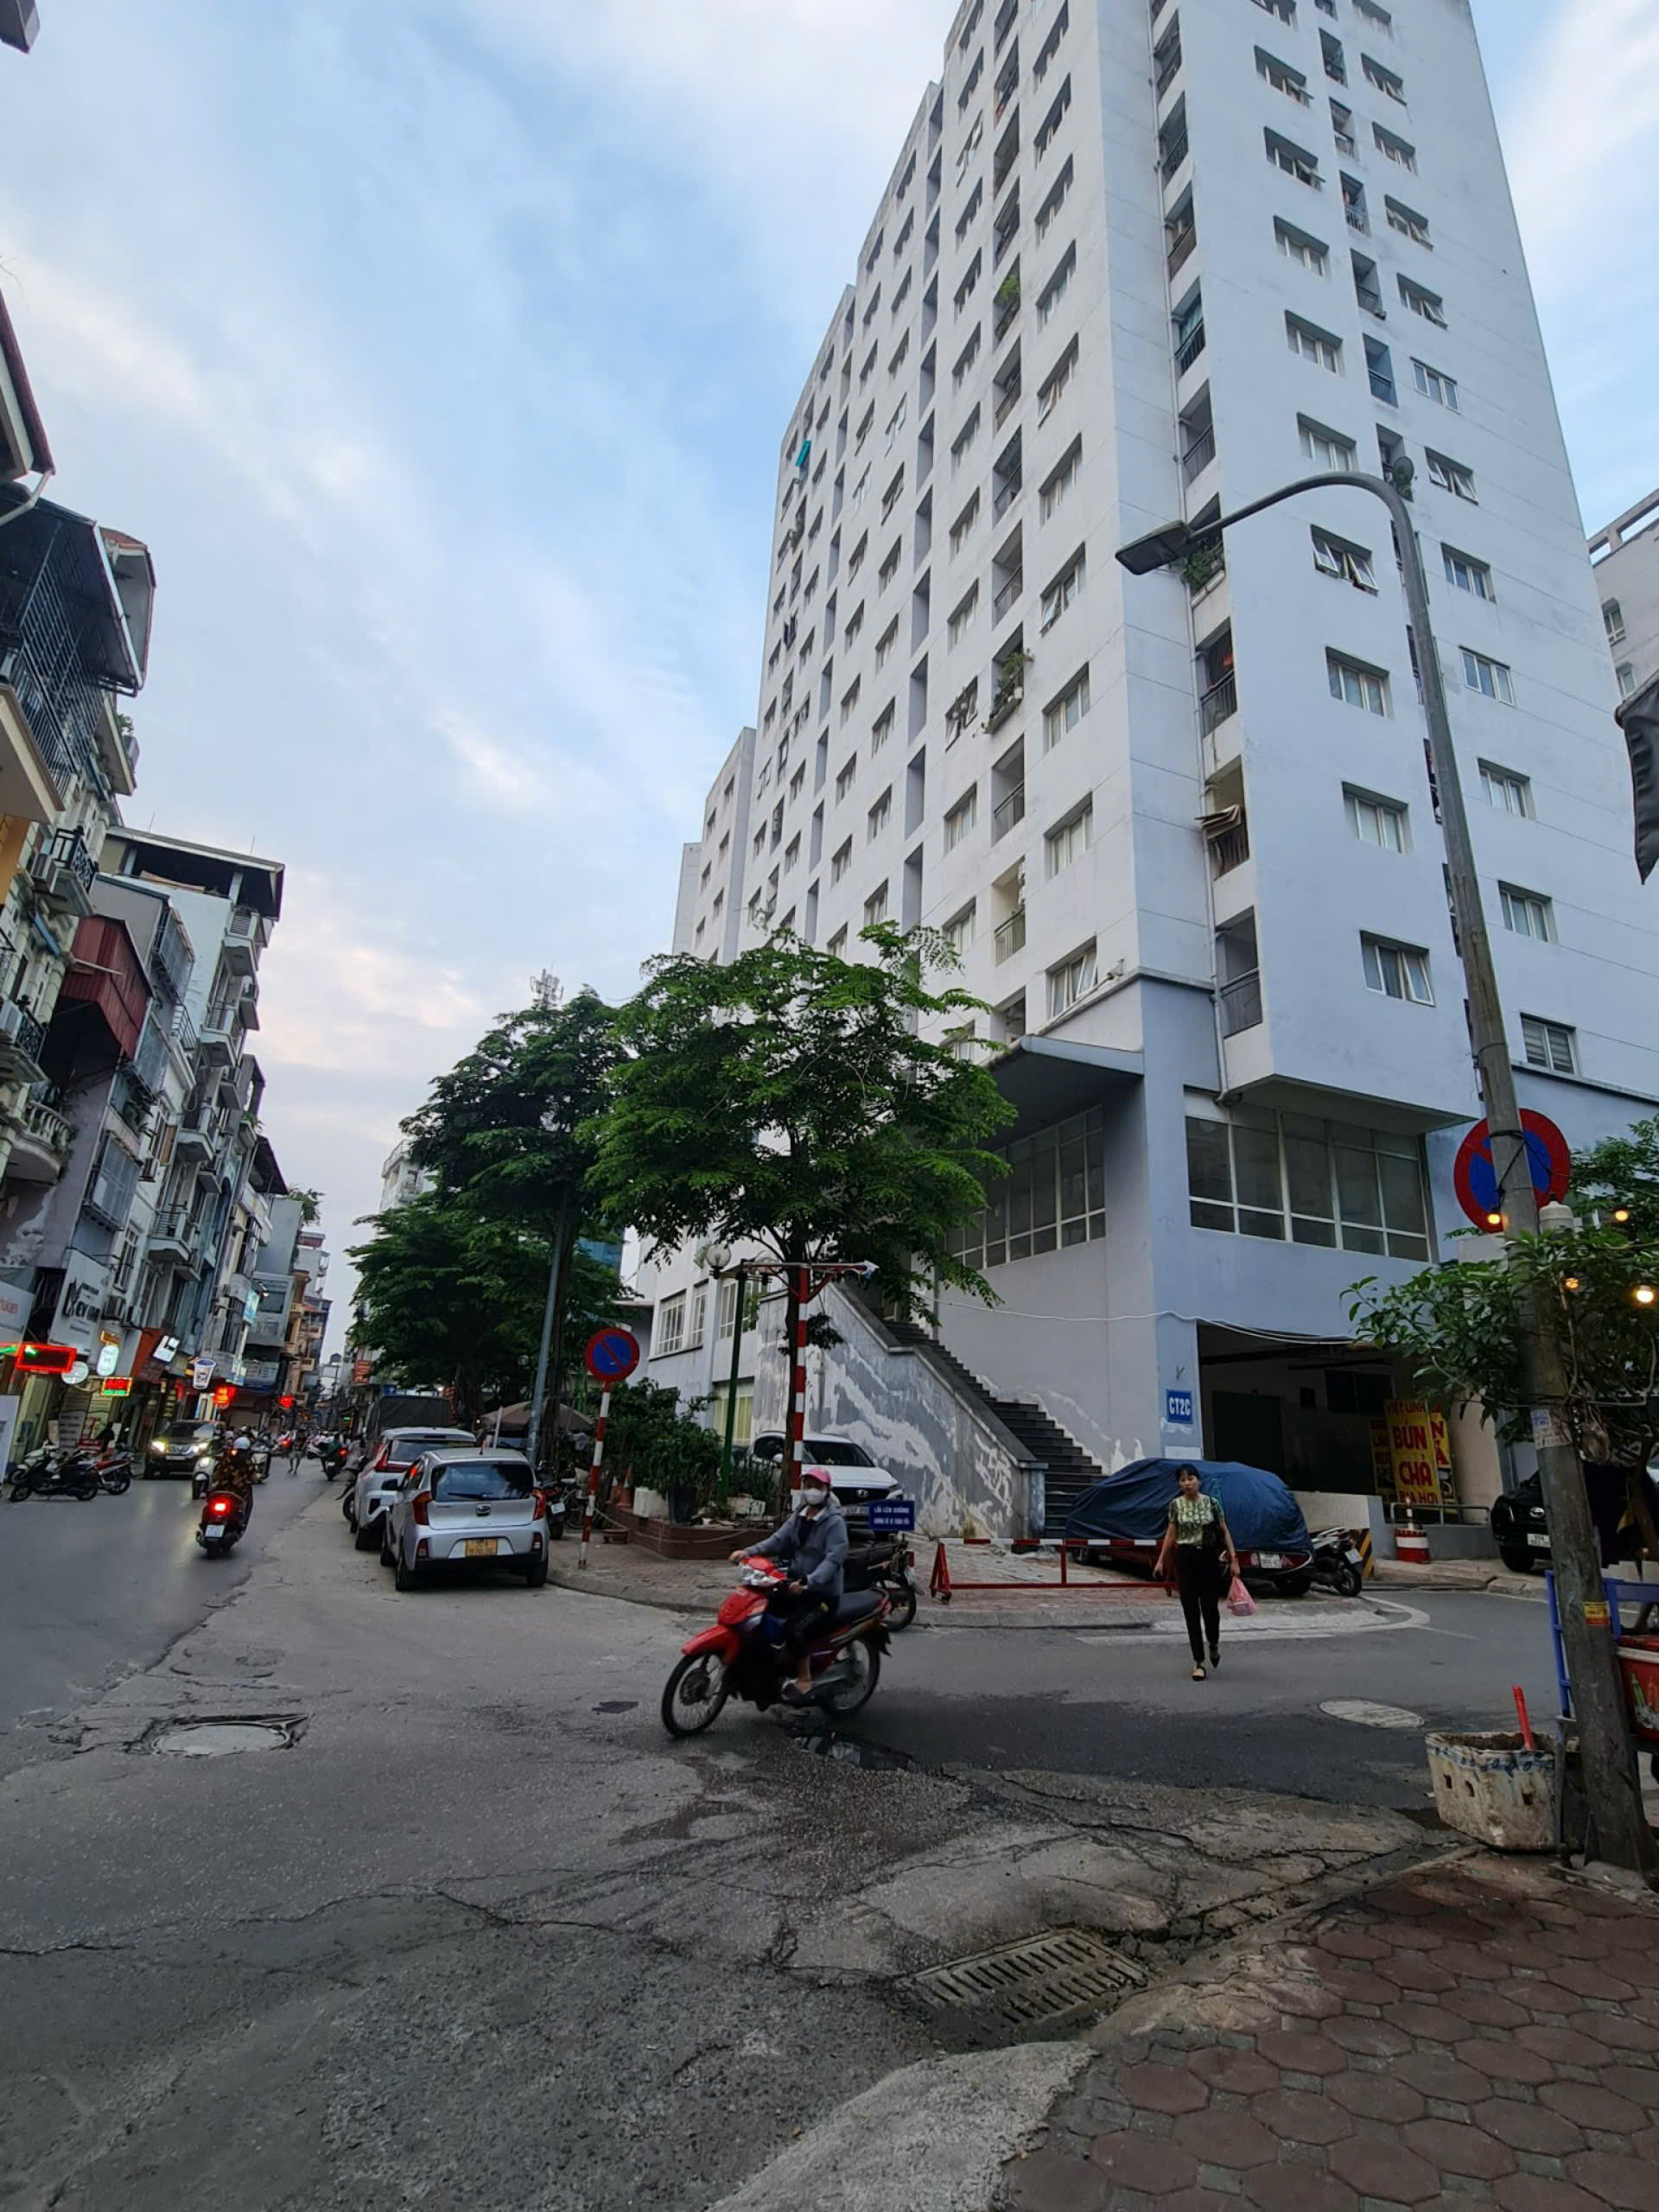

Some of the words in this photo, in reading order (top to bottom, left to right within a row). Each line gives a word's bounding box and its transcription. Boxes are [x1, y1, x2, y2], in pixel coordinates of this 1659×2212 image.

[1169, 1396, 1190, 1415] CT2C
[1392, 1420, 1427, 1449] BÚN
[1399, 1453, 1432, 1486] CHẢ
